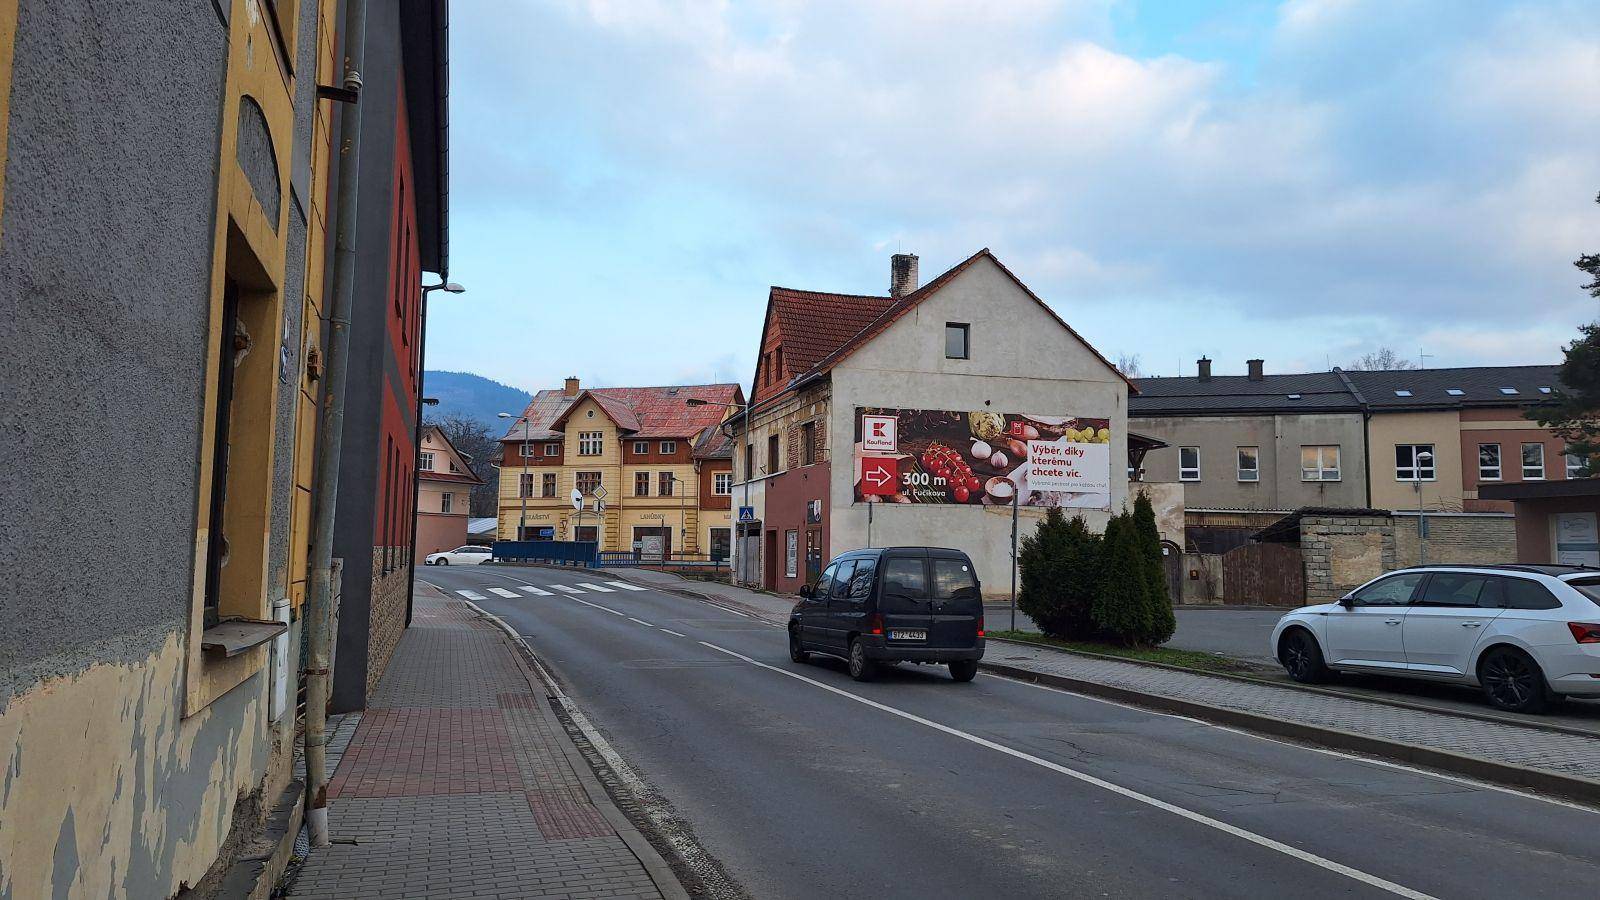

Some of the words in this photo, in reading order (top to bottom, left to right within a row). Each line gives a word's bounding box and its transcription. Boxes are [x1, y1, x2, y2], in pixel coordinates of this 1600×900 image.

[1032, 445, 1062, 456] Výběr,
[1064, 447, 1084, 458] díky
[1031, 456, 1072, 467] kterému
[1032, 467, 1063, 477] chcete
[1066, 469, 1082, 478] víc.
[902, 472, 929, 485] 300
[933, 476, 946, 485] m
[902, 488, 911, 496] ul.
[913, 488, 946, 497] Fučíkova
